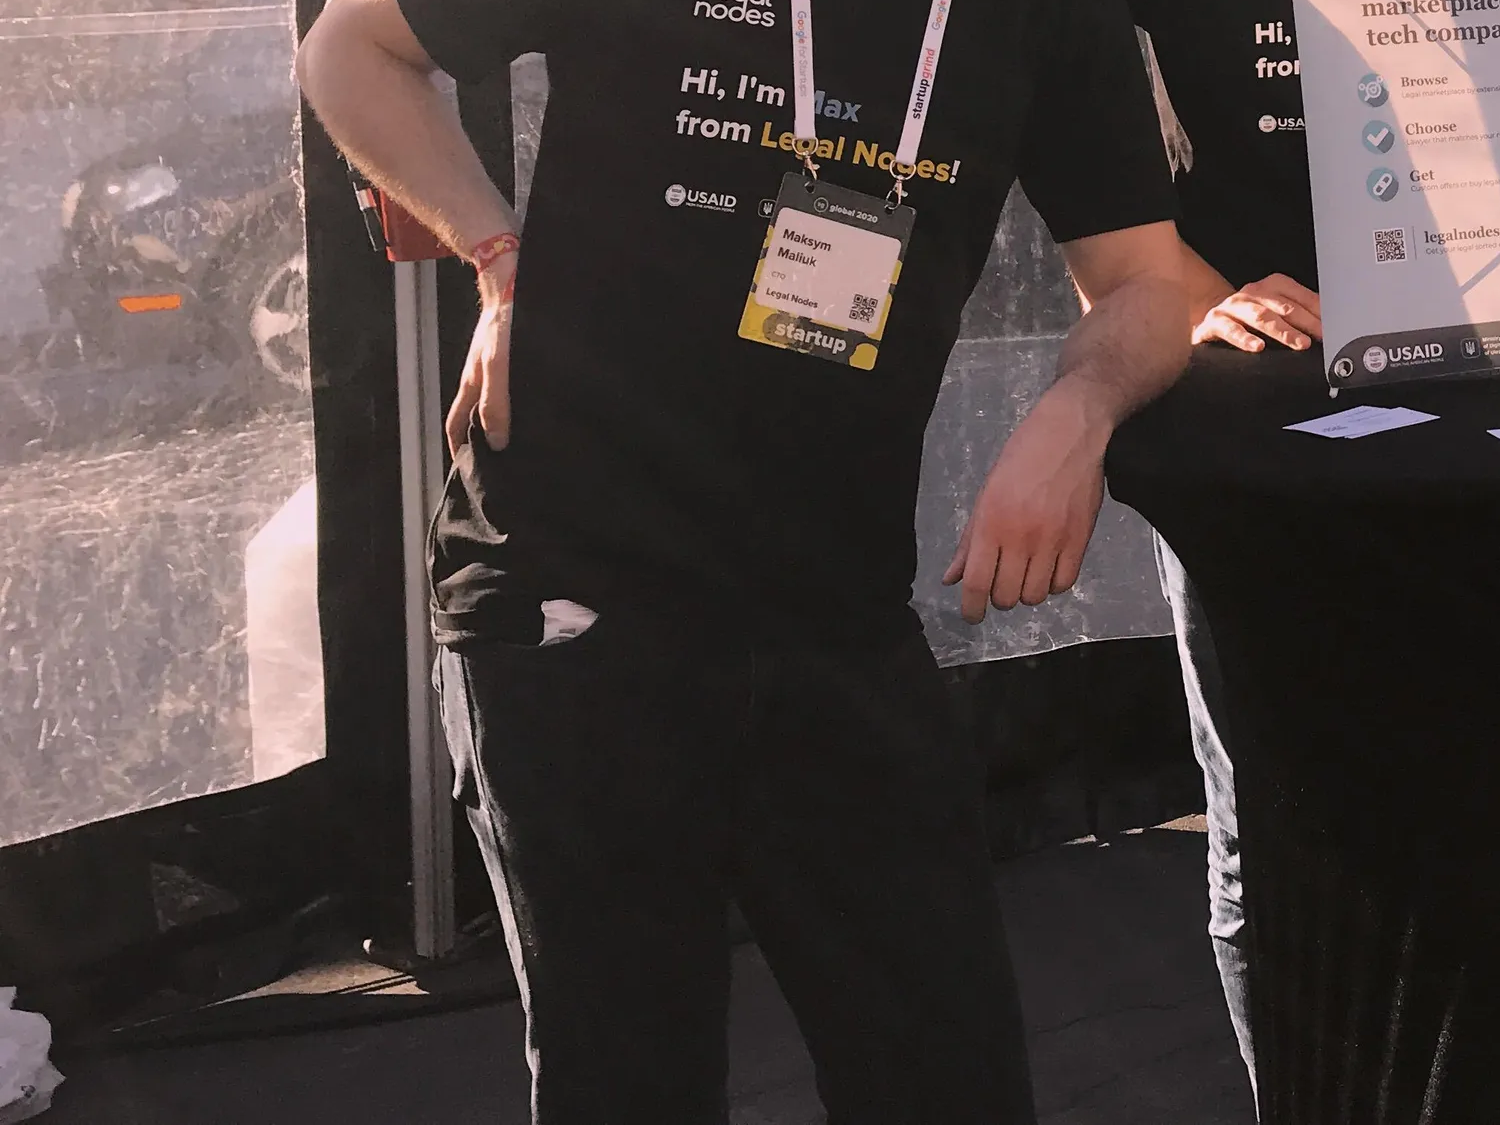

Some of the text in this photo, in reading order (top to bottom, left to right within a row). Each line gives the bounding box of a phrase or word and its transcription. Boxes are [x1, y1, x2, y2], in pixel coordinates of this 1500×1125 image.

[693, 0, 775, 27] nodes
[932, 0, 947, 31] Google
[795, 11, 807, 44] Google
[1255, 21, 1292, 46] Hi,
[1366, 24, 1418, 46] tech
[680, 67, 785, 108] Hi, I'm
[913, 48, 935, 120] startupgrind
[1401, 75, 1449, 88] Browse
[1277, 117, 1306, 127] USA
[1405, 122, 1457, 136] Choose
[676, 109, 751, 144] from
[760, 121, 845, 161] Legal
[1410, 169, 1435, 183] Get
[687, 189, 737, 208] USAID
[829, 204, 879, 224] global 2020
[782, 228, 832, 252] Maksym
[777, 246, 818, 267] Maliuk
[771, 271, 786, 280] CTO
[766, 287, 818, 309] Legal Nodes
[774, 322, 847, 354] startup
[1388, 343, 1443, 362] USAID
